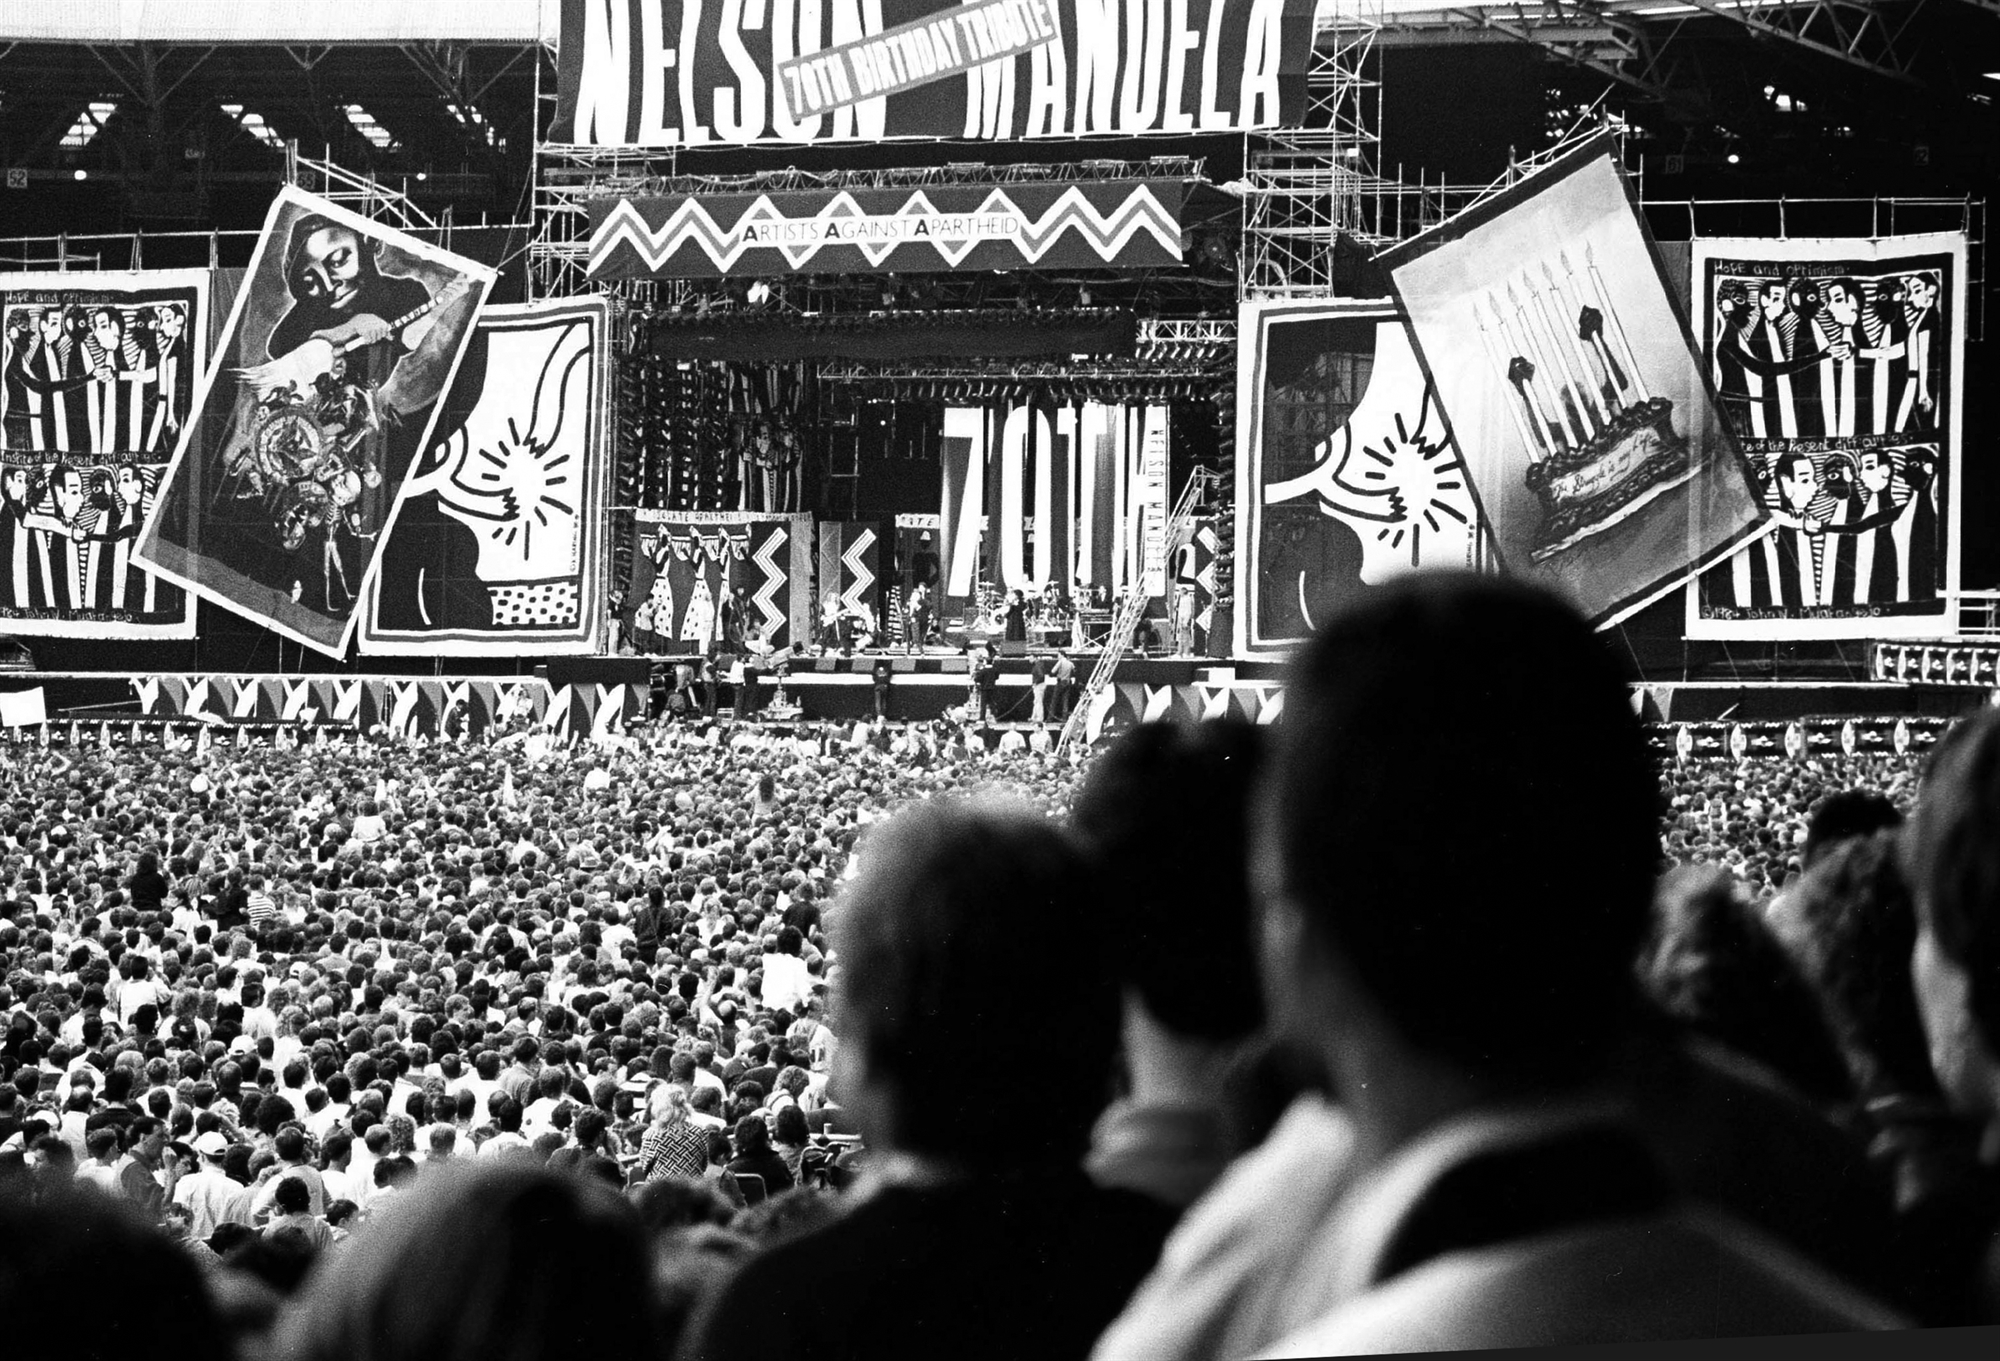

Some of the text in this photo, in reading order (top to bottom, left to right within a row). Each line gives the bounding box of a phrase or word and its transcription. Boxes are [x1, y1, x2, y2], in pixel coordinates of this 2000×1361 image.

[574, 0, 887, 145] NELSON
[784, 0, 1054, 115] 70TH BIRTHDAY TRIBUTE
[743, 216, 1020, 242] ARTISTS AGAINST APARTHEID
[1753, 262, 1780, 276] and
